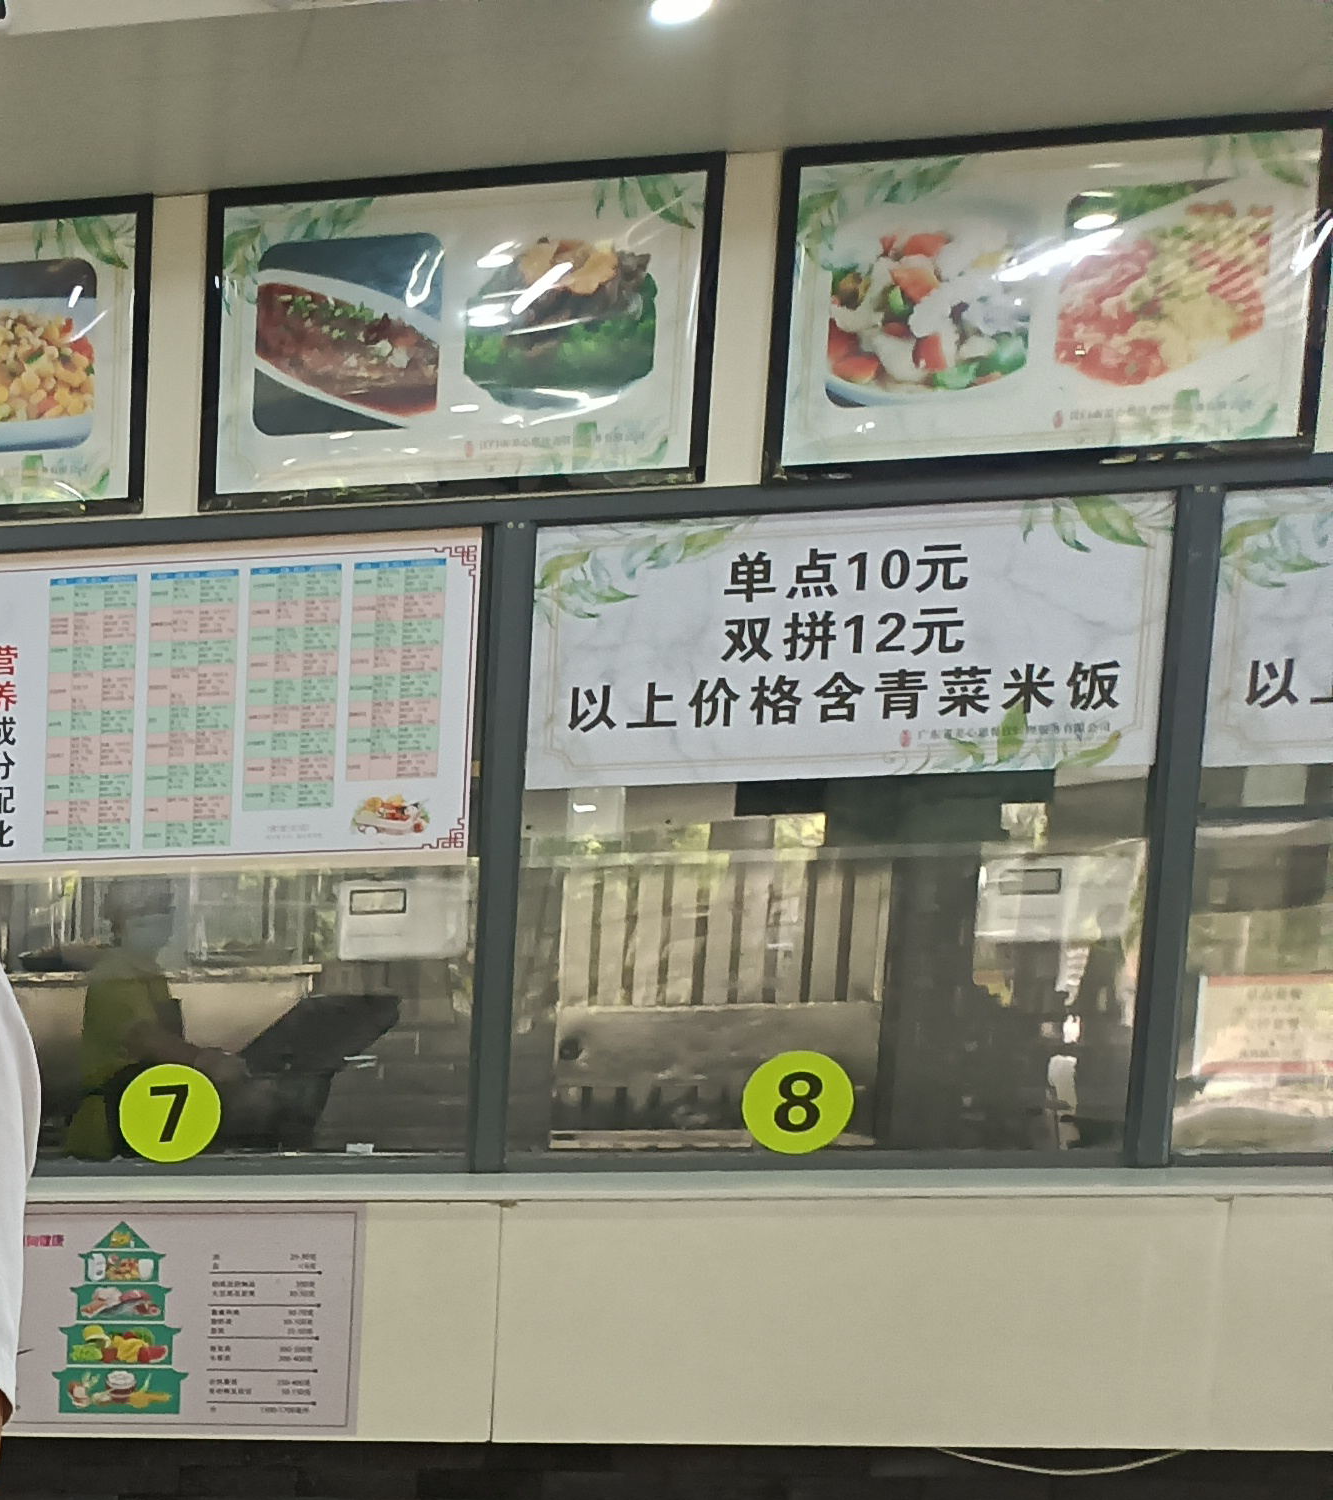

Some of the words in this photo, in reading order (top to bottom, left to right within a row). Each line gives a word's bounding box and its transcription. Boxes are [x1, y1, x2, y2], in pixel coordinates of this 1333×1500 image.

[724, 543, 970, 602] 单点10元
[720, 606, 966, 663] 双拼12元
[567, 659, 1122, 733] 以上价格含青菜米饭
[149, 1084, 190, 1143] 7
[773, 1071, 823, 1132] 8
